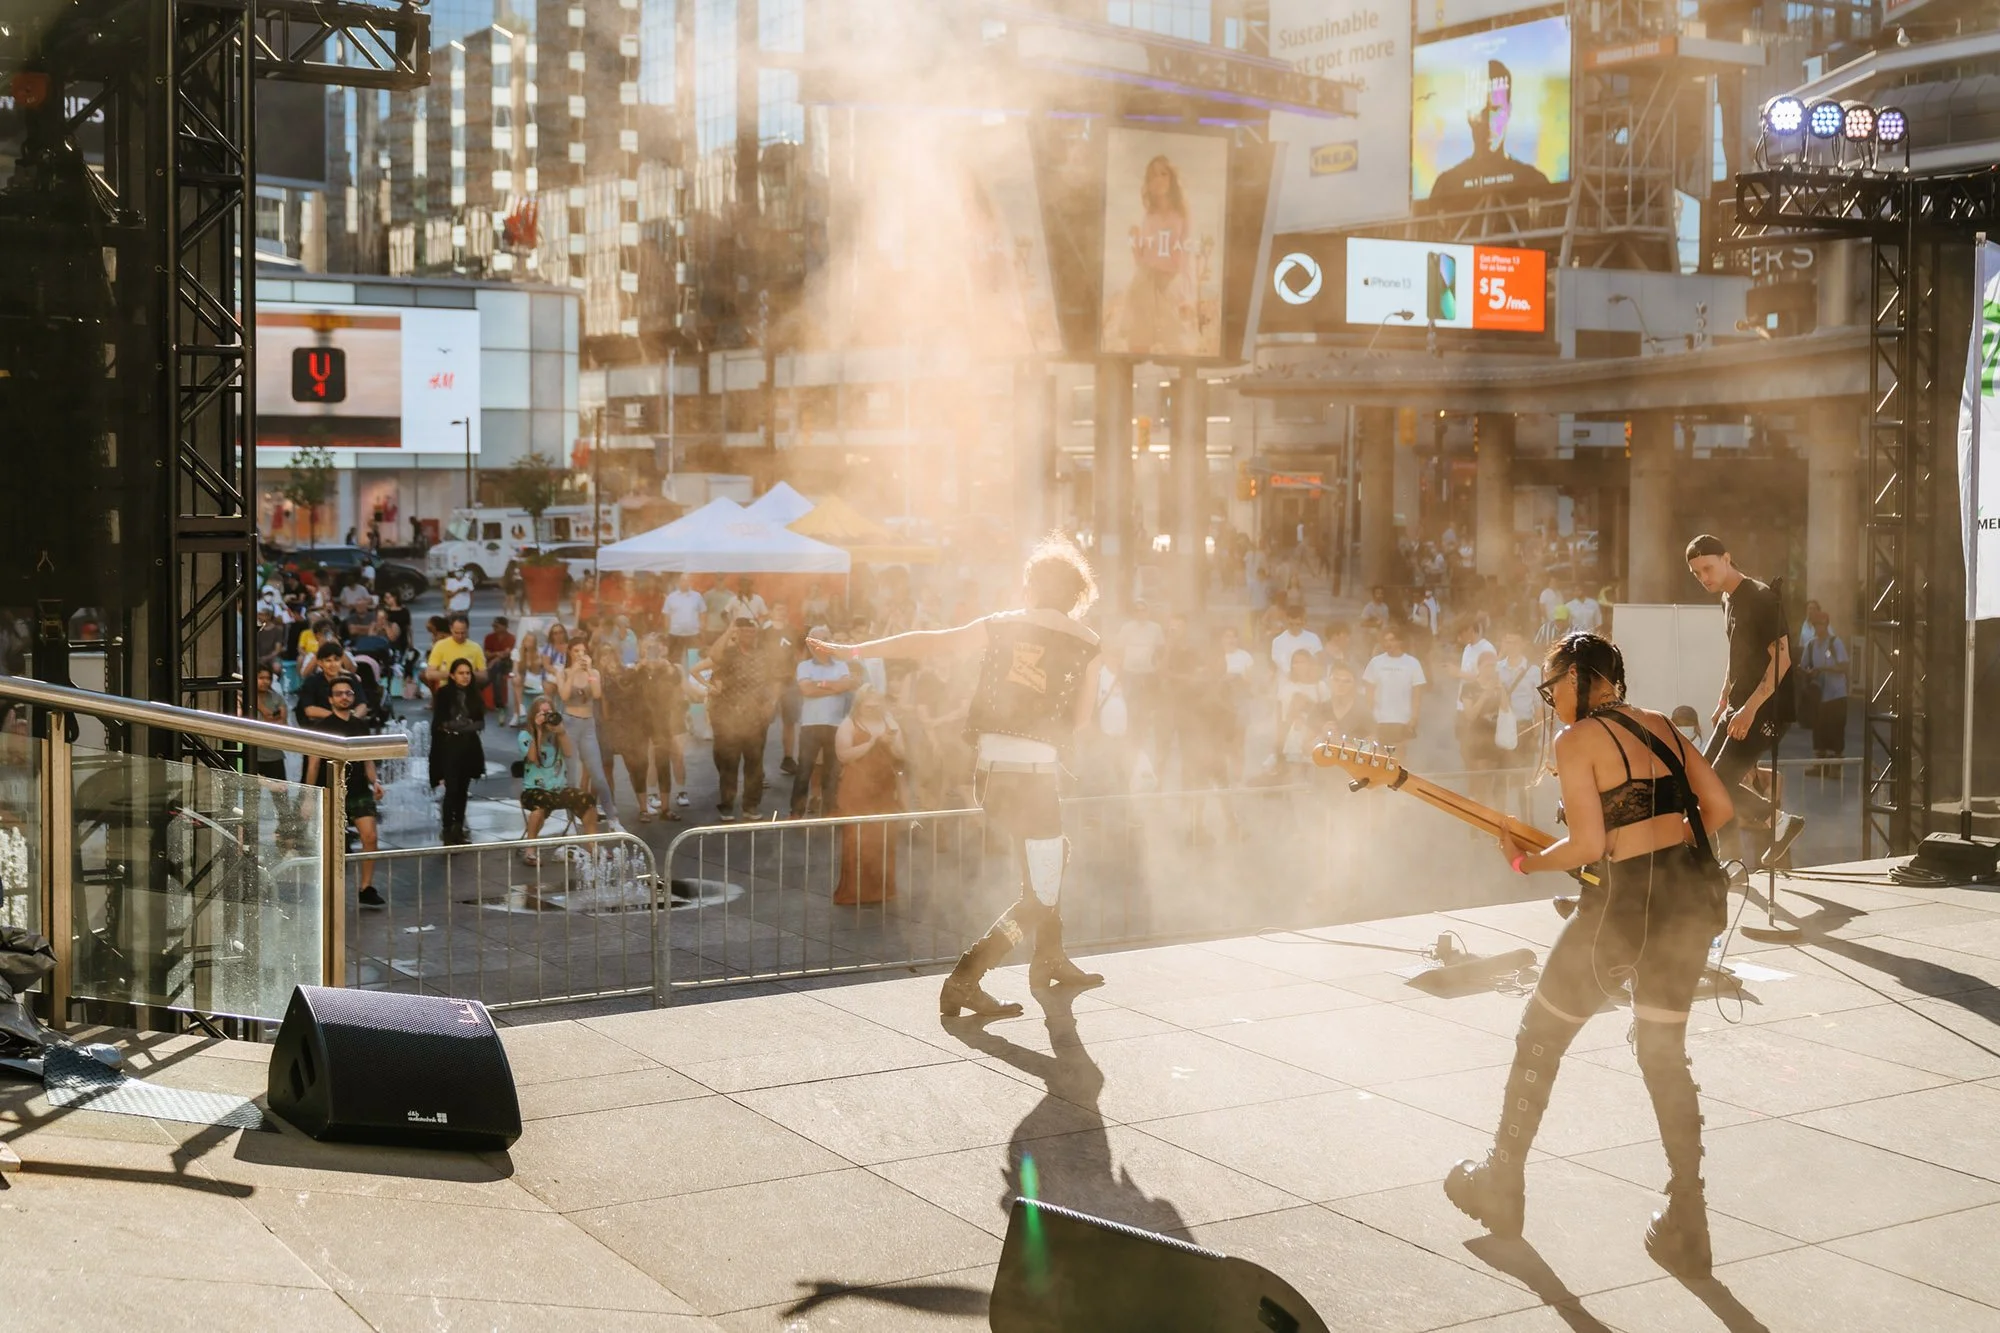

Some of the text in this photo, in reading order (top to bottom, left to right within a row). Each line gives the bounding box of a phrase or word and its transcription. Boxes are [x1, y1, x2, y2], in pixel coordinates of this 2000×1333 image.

[1278, 9, 1379, 50] Sustainable
[1315, 49, 1343, 76] got
[1349, 40, 1395, 64] more
[1371, 276, 1412, 289] iPhone 13
[1977, 517, 2000, 532] ME
